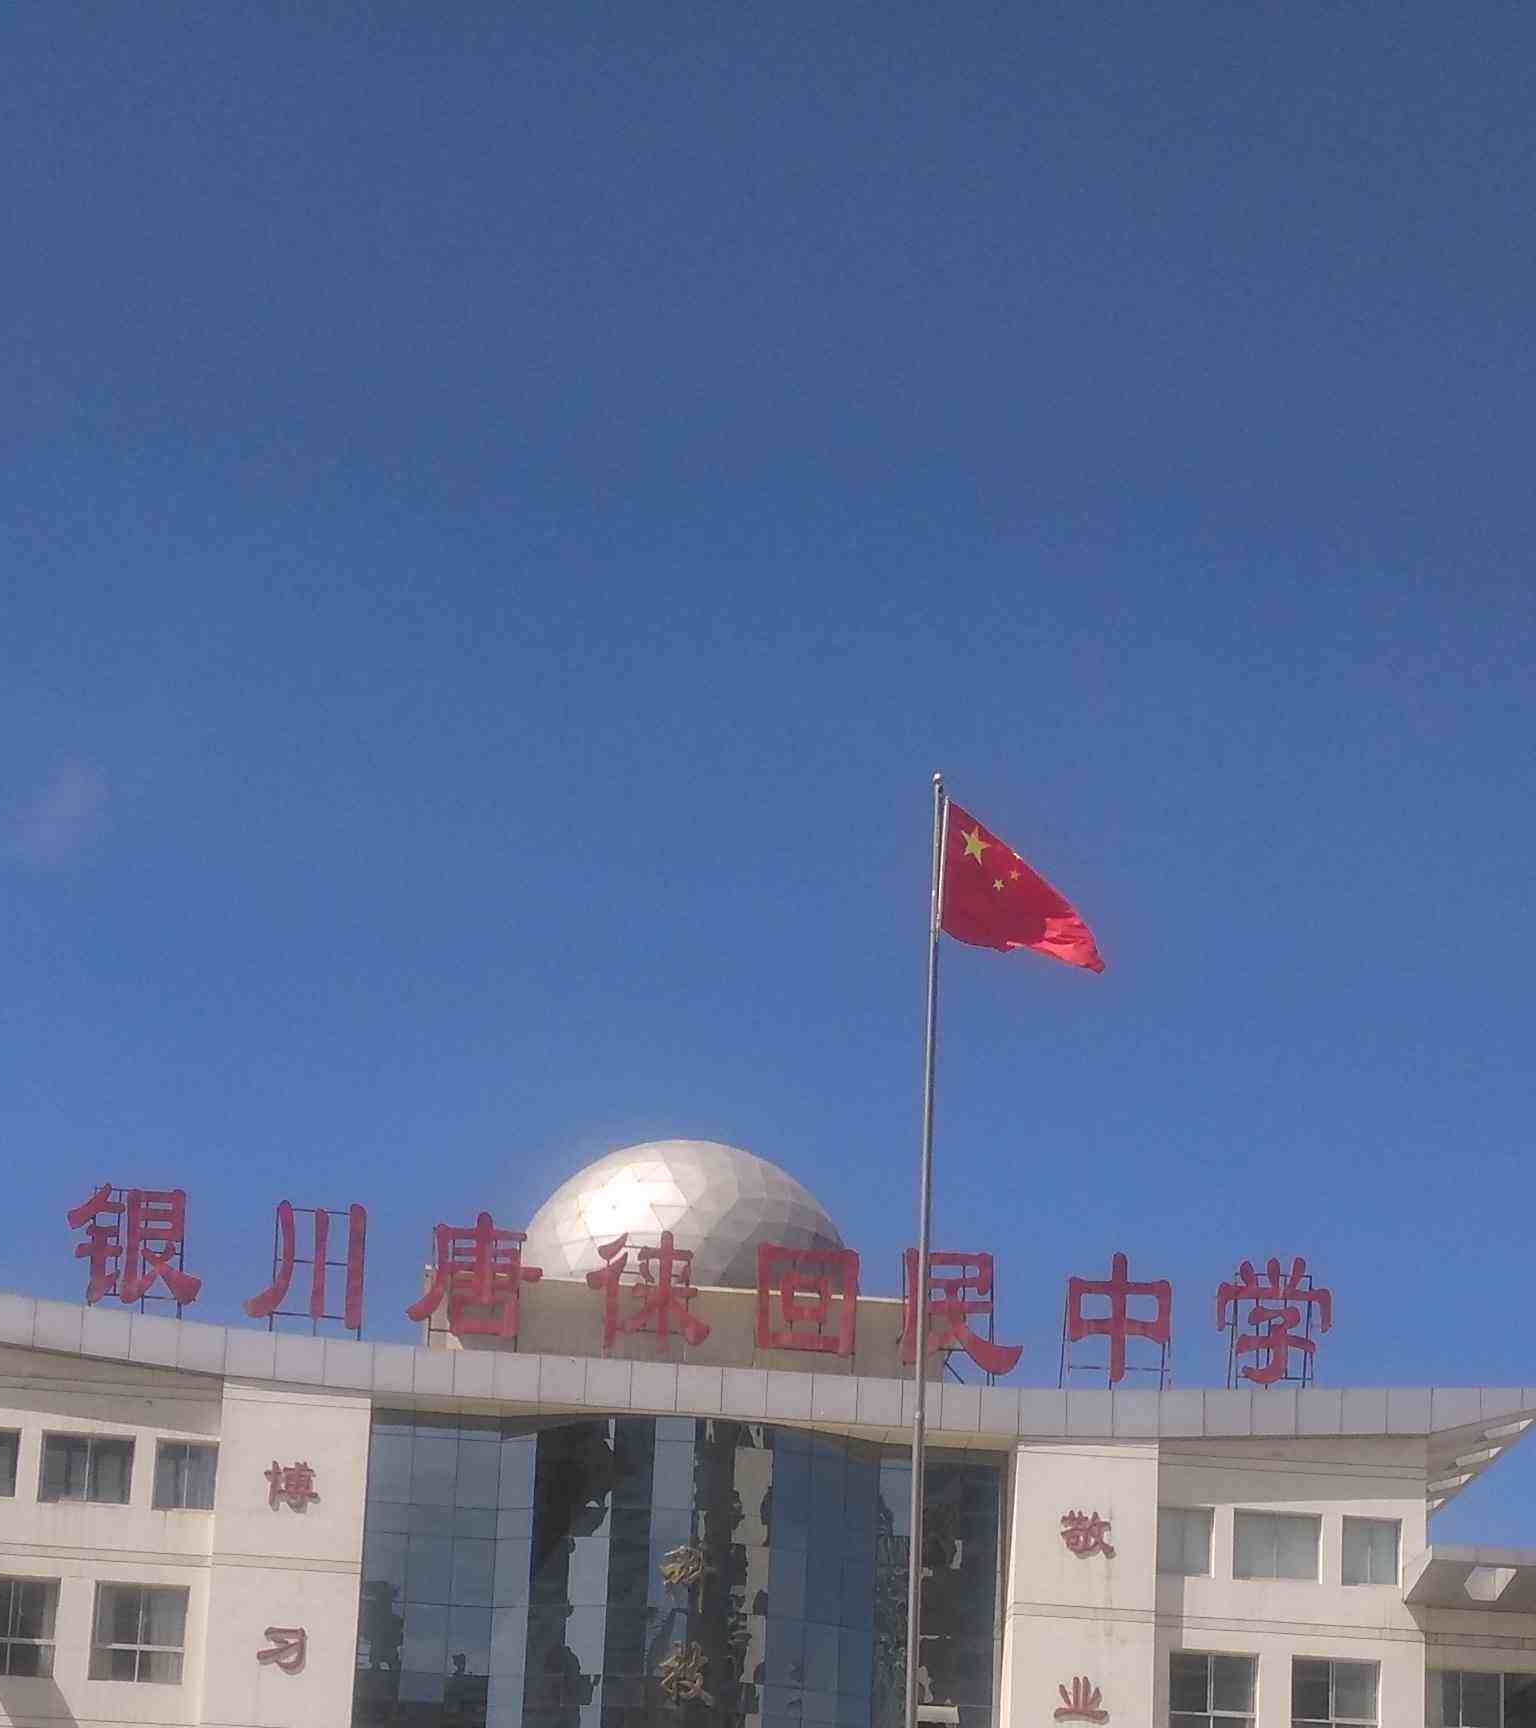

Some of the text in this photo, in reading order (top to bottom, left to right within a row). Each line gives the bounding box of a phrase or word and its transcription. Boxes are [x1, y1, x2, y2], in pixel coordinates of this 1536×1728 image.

[66, 1182, 1335, 1387] 银川唐徕回民中学
